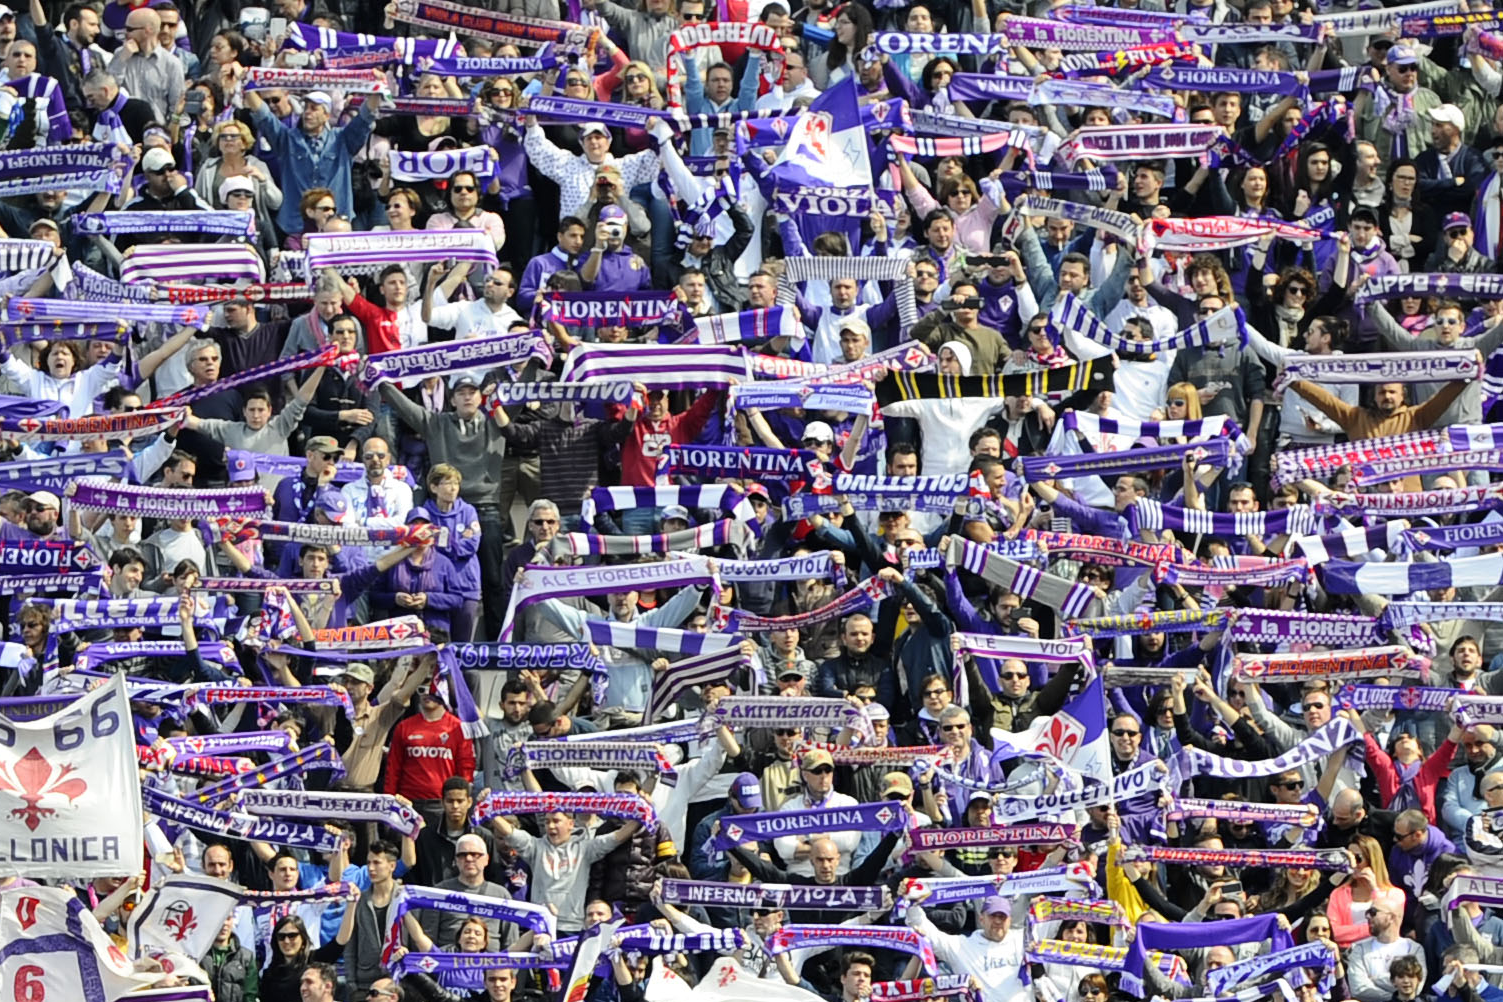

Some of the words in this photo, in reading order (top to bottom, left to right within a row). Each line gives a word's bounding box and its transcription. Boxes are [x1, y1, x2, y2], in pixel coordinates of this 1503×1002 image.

[1056, 27, 1140, 43] FIORENTINA
[456, 57, 543, 73] FIORENTINA
[1178, 70, 1280, 86] FIORENTINA
[779, 193, 894, 216] VIOLA
[497, 384, 628, 401] COLLETTIVO
[46, 413, 157, 432] FIORENTINA
[671, 449, 803, 471] FIORENTINA
[836, 475, 968, 492] COLLETTIVO
[137, 495, 218, 511] FIORENTINA
[587, 559, 695, 584] FIORENTINA
[1290, 620, 1376, 636] FIORENT
[1268, 654, 1387, 674] FIORENTINA
[407, 747, 453, 760] TOYOTA
[536, 750, 649, 762] FIORENTINA
[755, 811, 864, 833] FIORENTINA
[922, 824, 1074, 847] FIORENTINA
[688, 887, 757, 904] INFERNO
